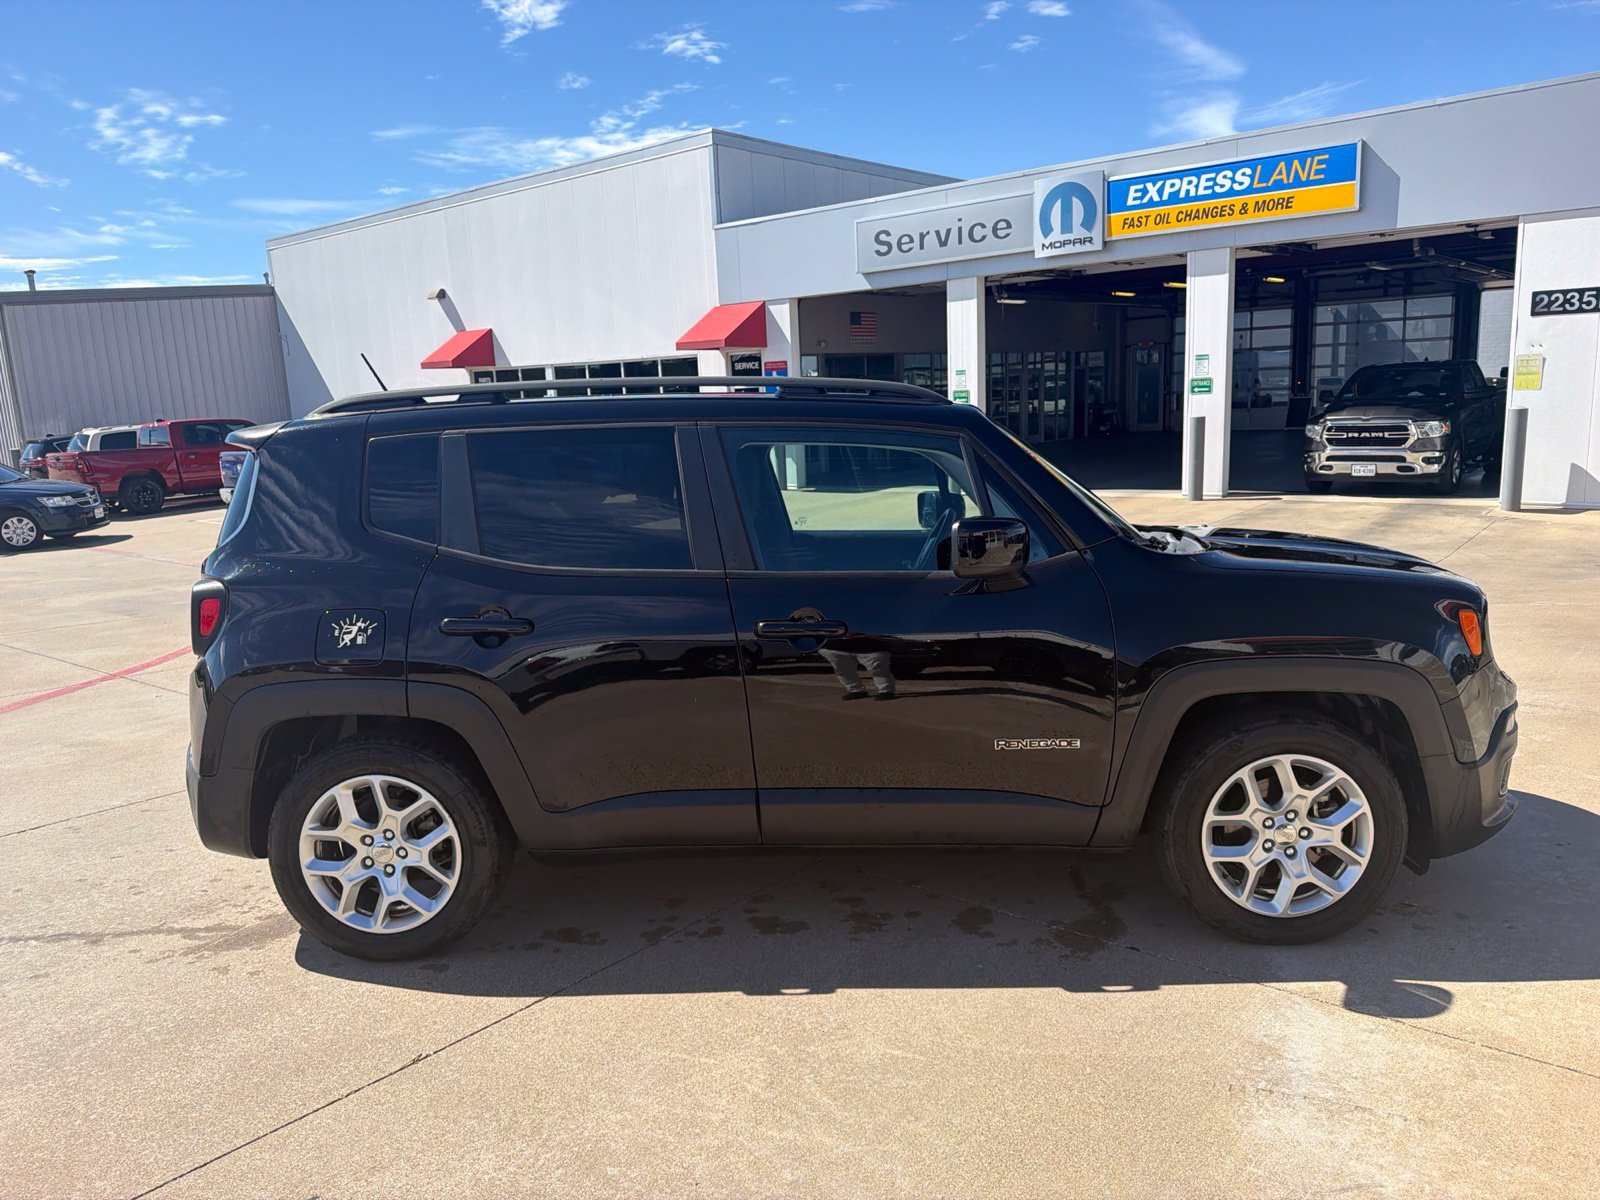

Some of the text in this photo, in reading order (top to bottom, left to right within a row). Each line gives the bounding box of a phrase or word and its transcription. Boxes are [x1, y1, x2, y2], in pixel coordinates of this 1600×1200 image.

[1122, 196, 1295, 230] FAST OIL CHANGES & MORE
[874, 218, 1013, 257] Service
[1041, 236, 1094, 251] MOPAR
[1534, 290, 1600, 312] 2235
[734, 361, 760, 371] SERVICE
[994, 739, 1080, 750] RENEGADE
